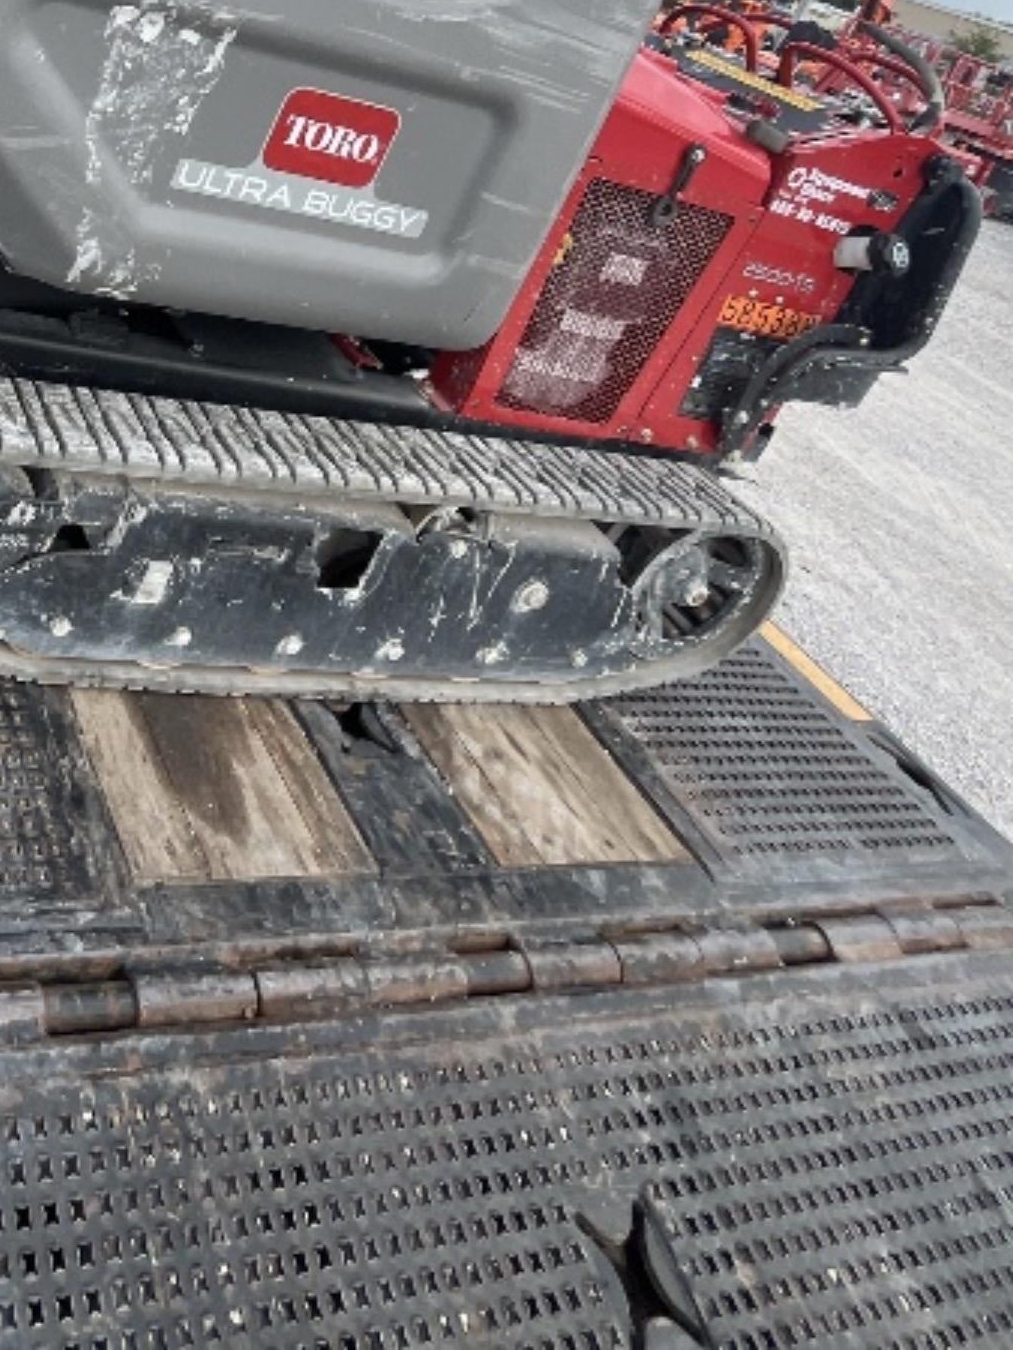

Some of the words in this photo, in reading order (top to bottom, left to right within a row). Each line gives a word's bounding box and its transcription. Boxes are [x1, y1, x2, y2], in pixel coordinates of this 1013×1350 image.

[284, 114, 379, 163] TORO
[178, 163, 291, 208] ULTRA
[302, 190, 421, 231] BUGGY
